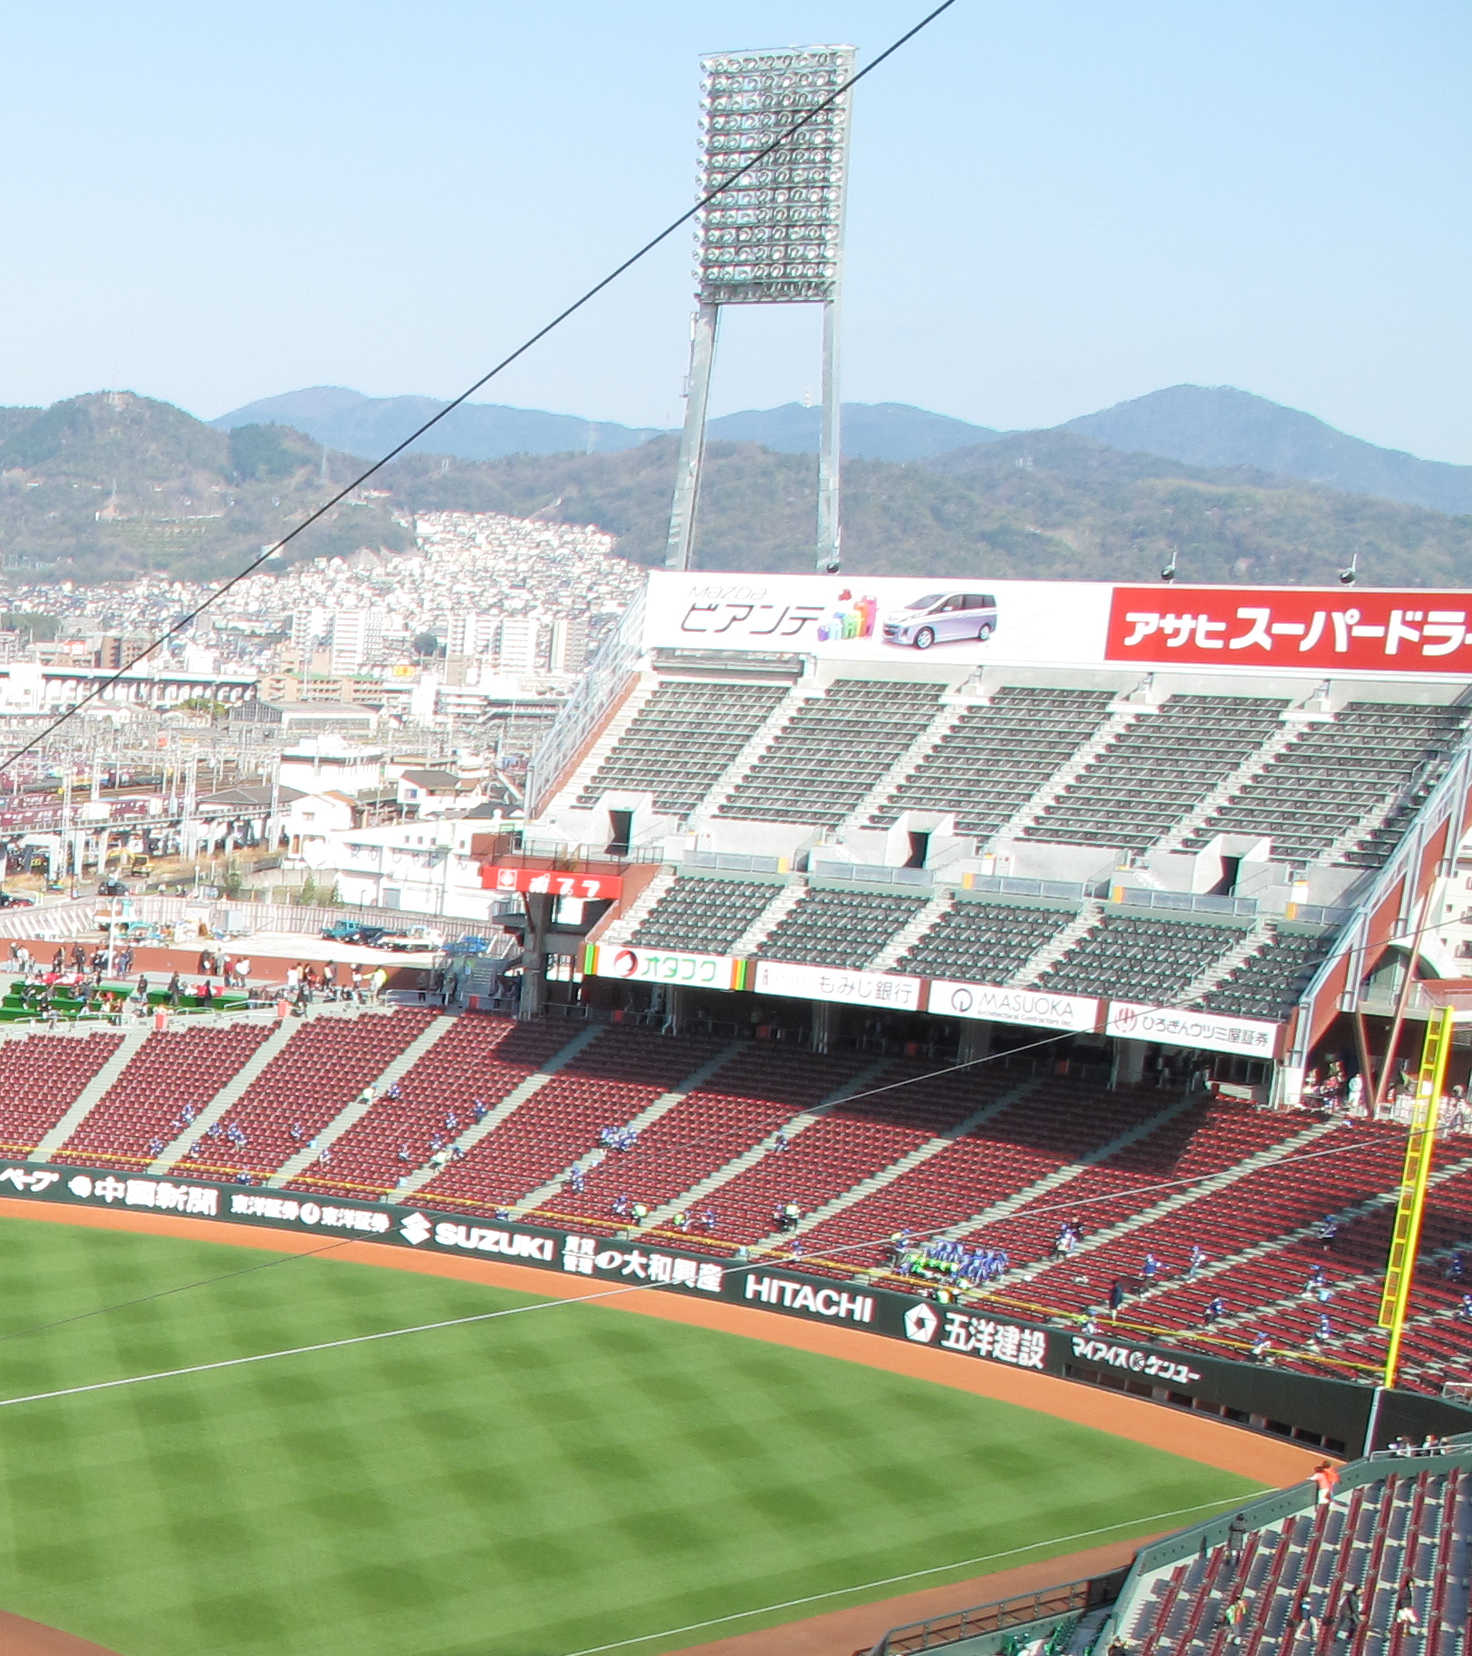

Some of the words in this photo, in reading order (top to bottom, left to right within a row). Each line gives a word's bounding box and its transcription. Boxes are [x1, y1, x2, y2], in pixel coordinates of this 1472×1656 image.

[680, 602, 826, 636] ビアンテ
[1123, 606, 1472, 656] アサヒスーパードラ
[529, 873, 601, 898] ポプラ
[641, 955, 717, 982] オタフク
[818, 974, 913, 1004] もみじ銀行
[977, 1009, 1019, 1021] Architectural
[1020, 1013, 1061, 1026] Contractors
[978, 991, 1074, 1019] MASUOKA
[1141, 1015, 1269, 1048] ひろぎんウツミ屋証券
[0, 1168, 61, 1193] ベープ
[434, 1222, 554, 1261] SUZUKI
[745, 1273, 874, 1324] HITACHI
[941, 1311, 1048, 1370] 五洋建設
